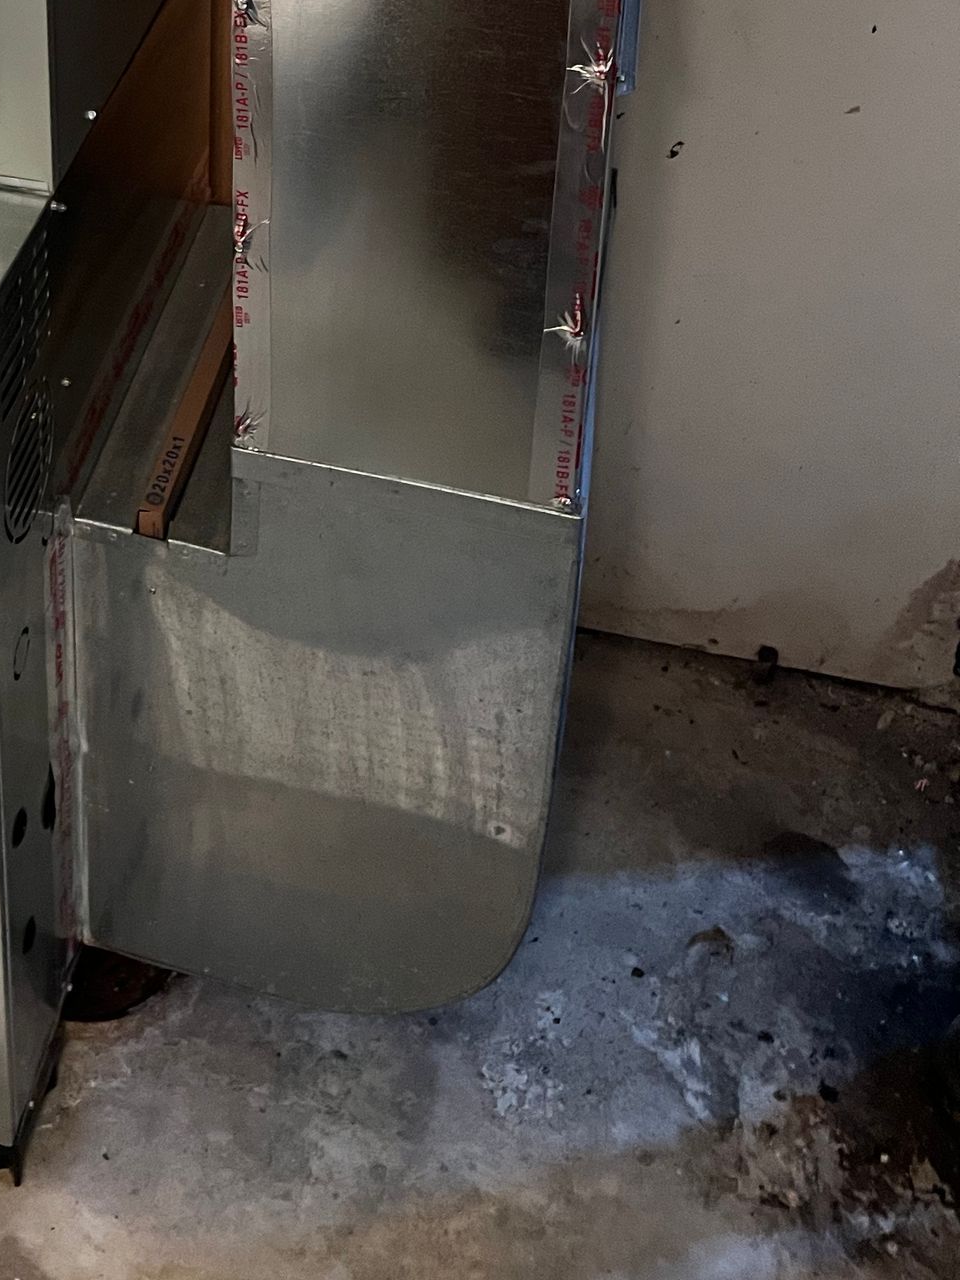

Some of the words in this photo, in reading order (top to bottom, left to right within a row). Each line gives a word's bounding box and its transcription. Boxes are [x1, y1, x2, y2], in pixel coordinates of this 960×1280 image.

[236, 80, 249, 130] 181A-P
[559, 393, 577, 438] 181A-P
[153, 435, 185, 493] 20x20x1
